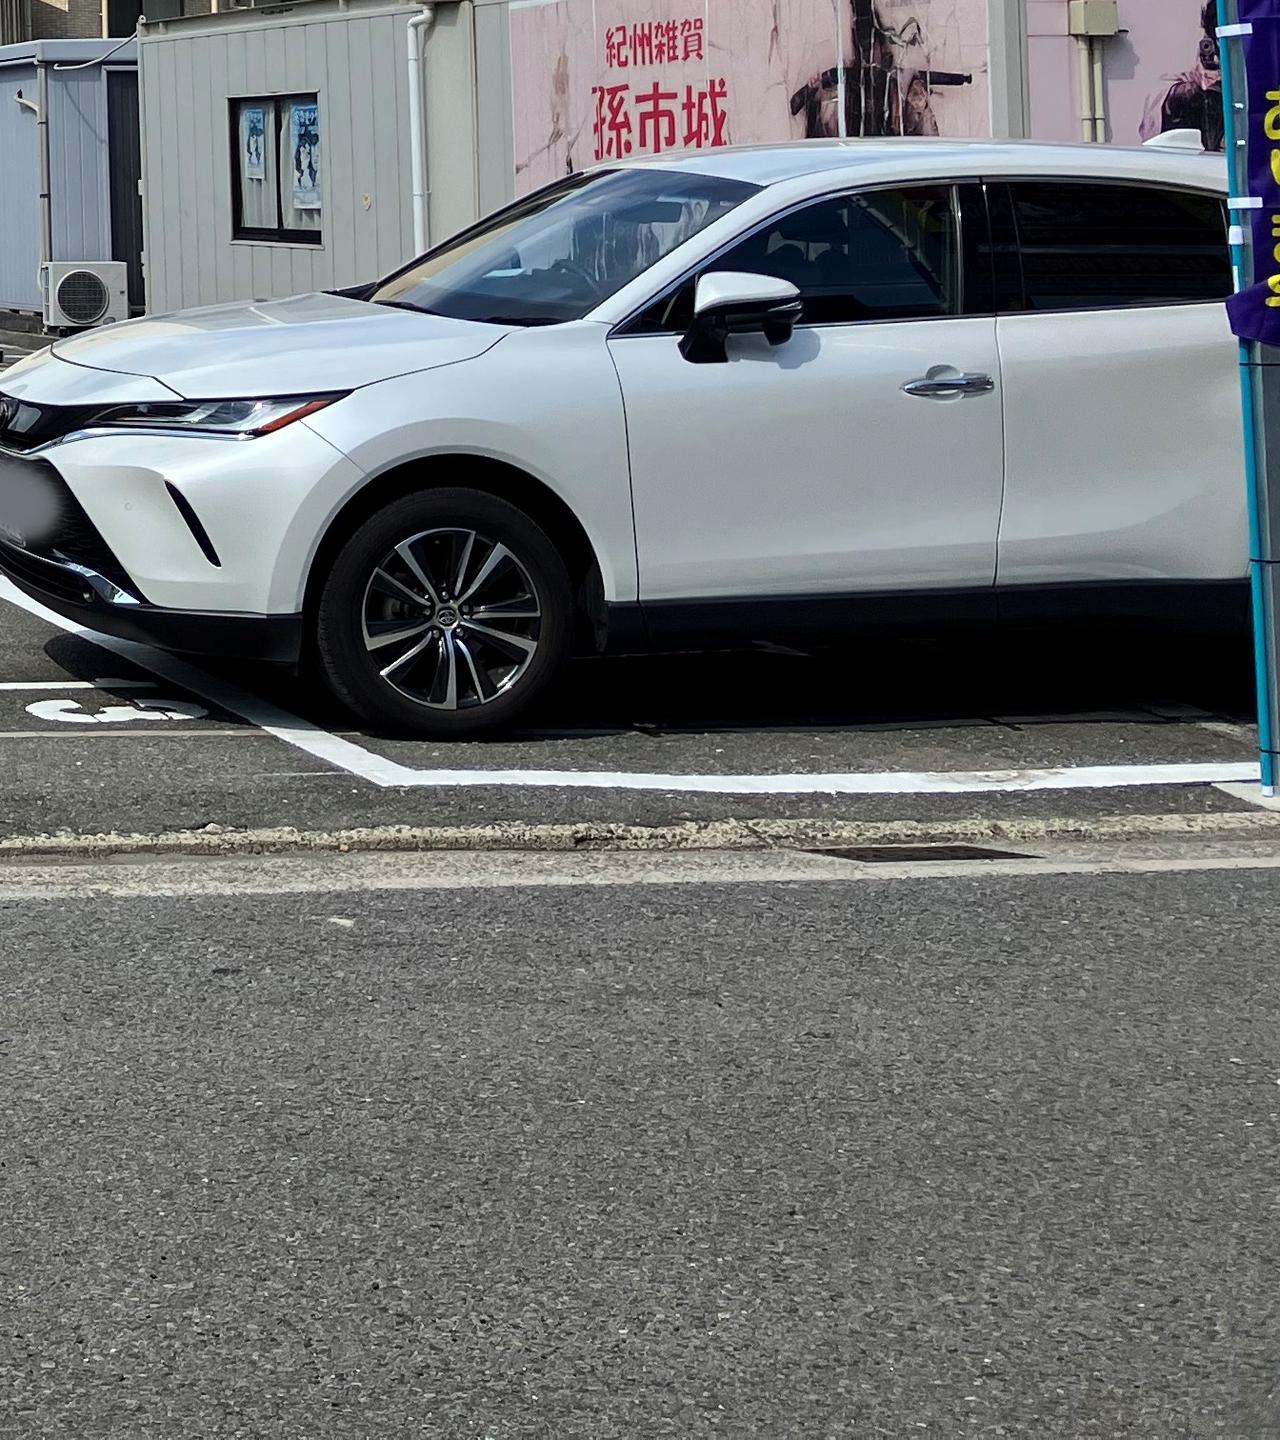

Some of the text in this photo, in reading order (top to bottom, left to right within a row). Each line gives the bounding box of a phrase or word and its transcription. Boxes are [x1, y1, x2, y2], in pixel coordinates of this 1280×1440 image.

[606, 18, 704, 68] 紀州雑賀
[591, 77, 728, 160] 孫市城
